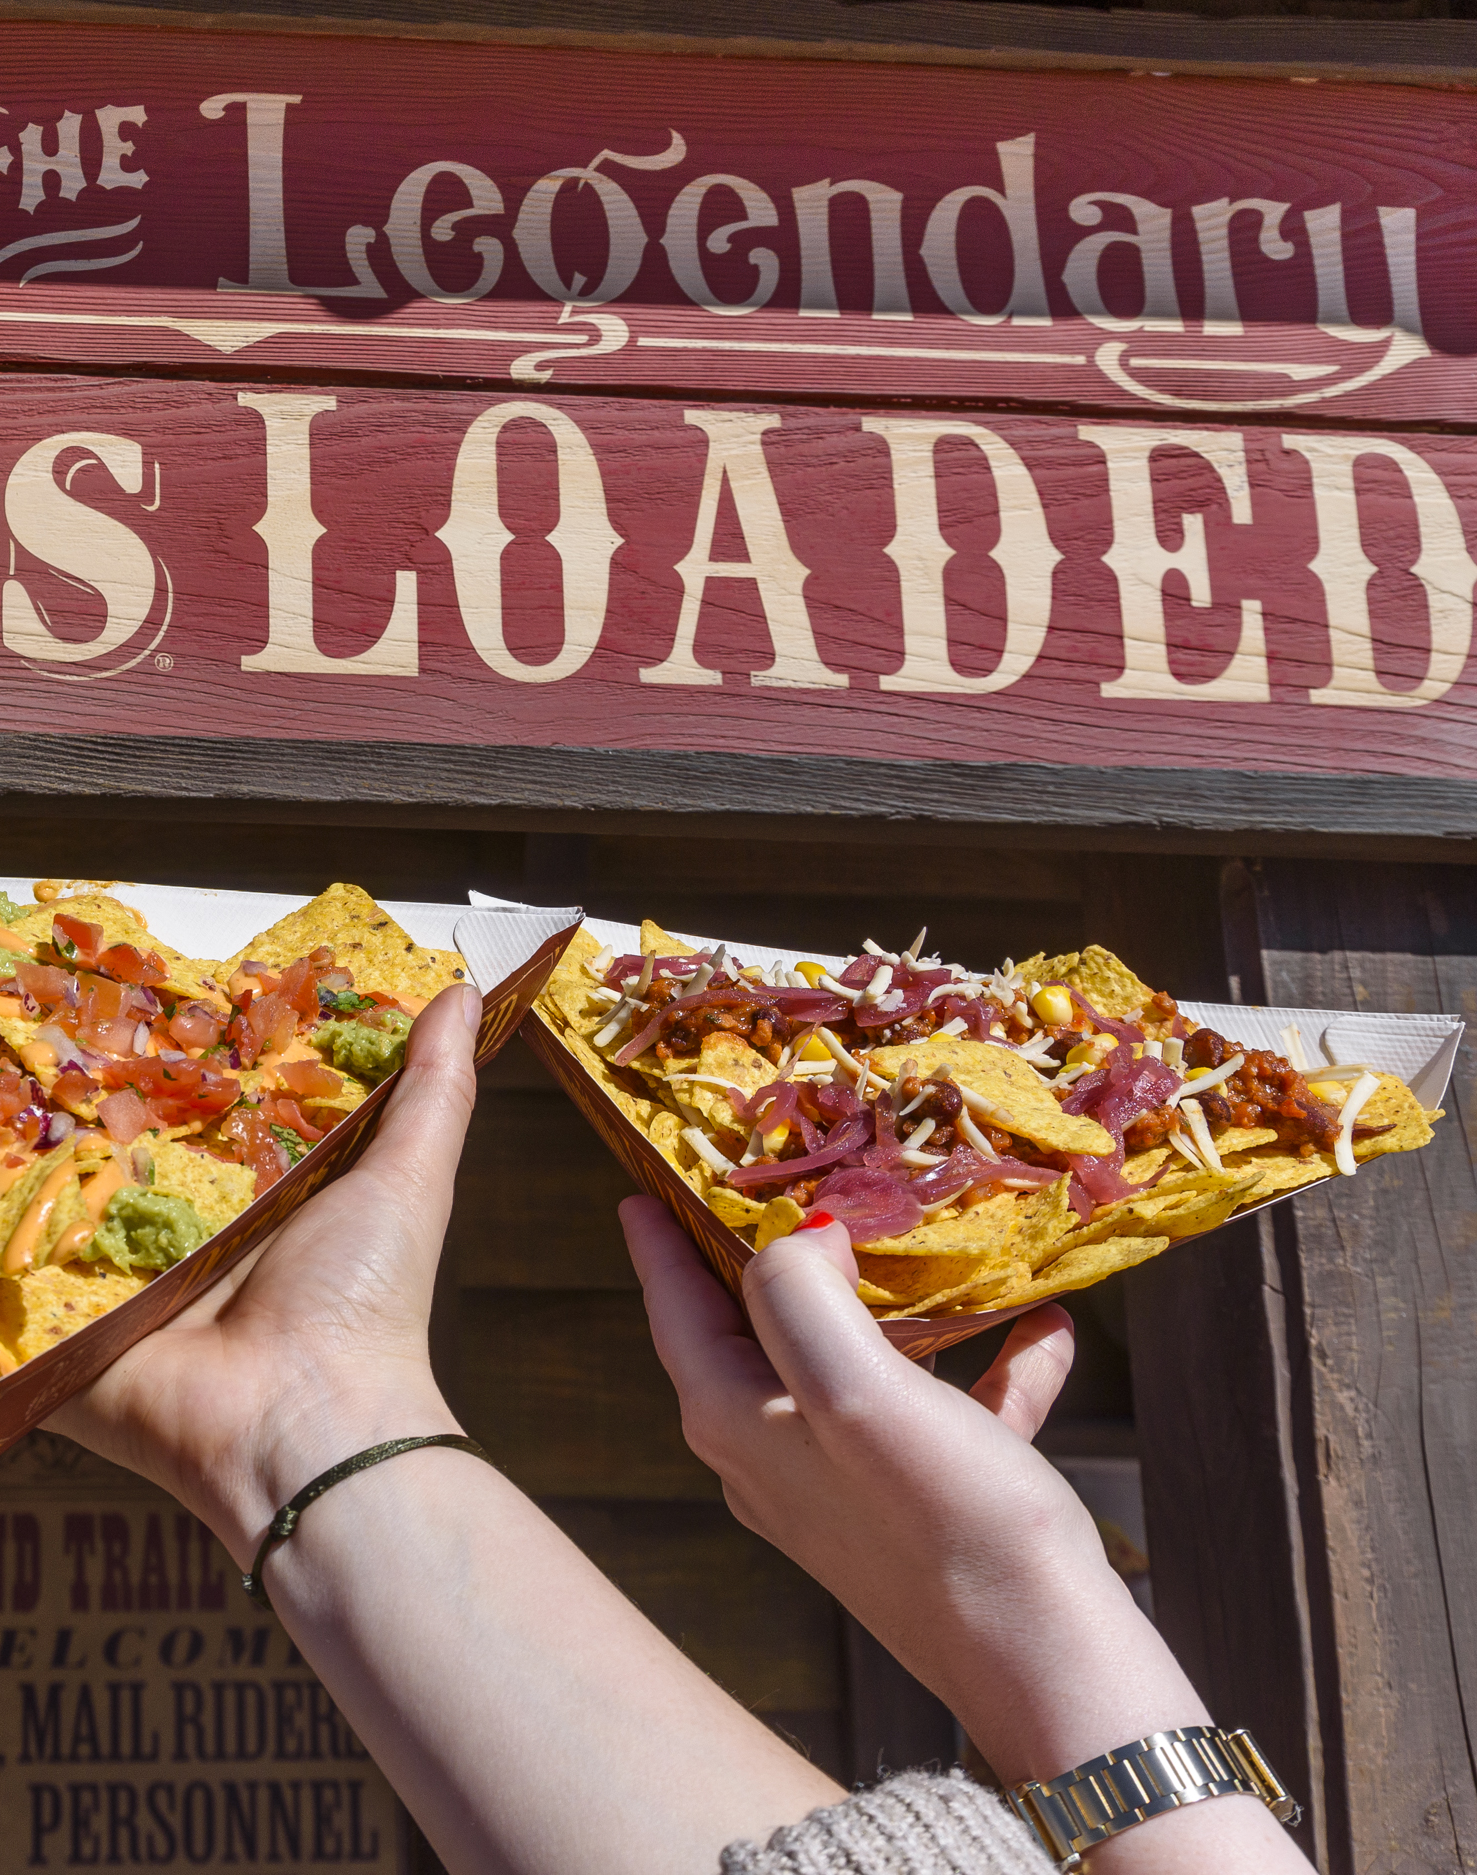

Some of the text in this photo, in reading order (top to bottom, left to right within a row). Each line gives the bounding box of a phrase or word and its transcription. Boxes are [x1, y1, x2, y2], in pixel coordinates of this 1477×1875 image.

[199, 93, 1431, 411] Legendary
[237, 391, 1477, 708] LOADED
[64, 1512, 230, 1614] TRAIL
[17, 1680, 159, 1765] MAIL
[28, 1778, 381, 1867] PERSONNEL
